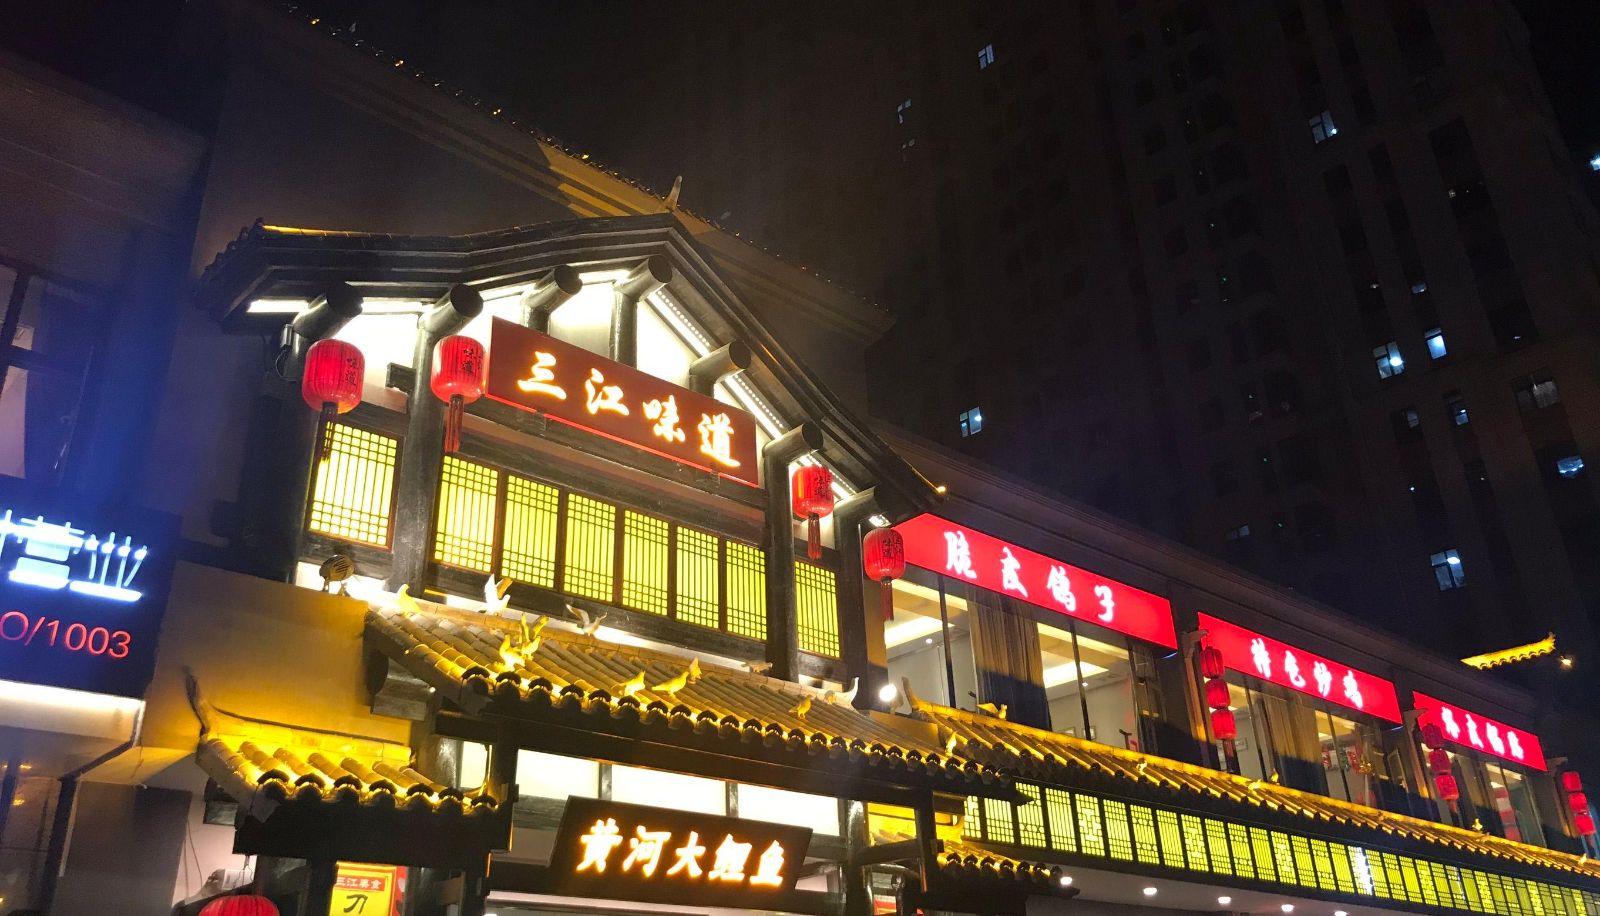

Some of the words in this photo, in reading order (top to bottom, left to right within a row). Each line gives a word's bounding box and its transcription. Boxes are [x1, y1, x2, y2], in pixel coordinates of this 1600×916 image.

[517, 351, 740, 467] 三江味道
[576, 818, 785, 886] 黄河大鲤鱼
